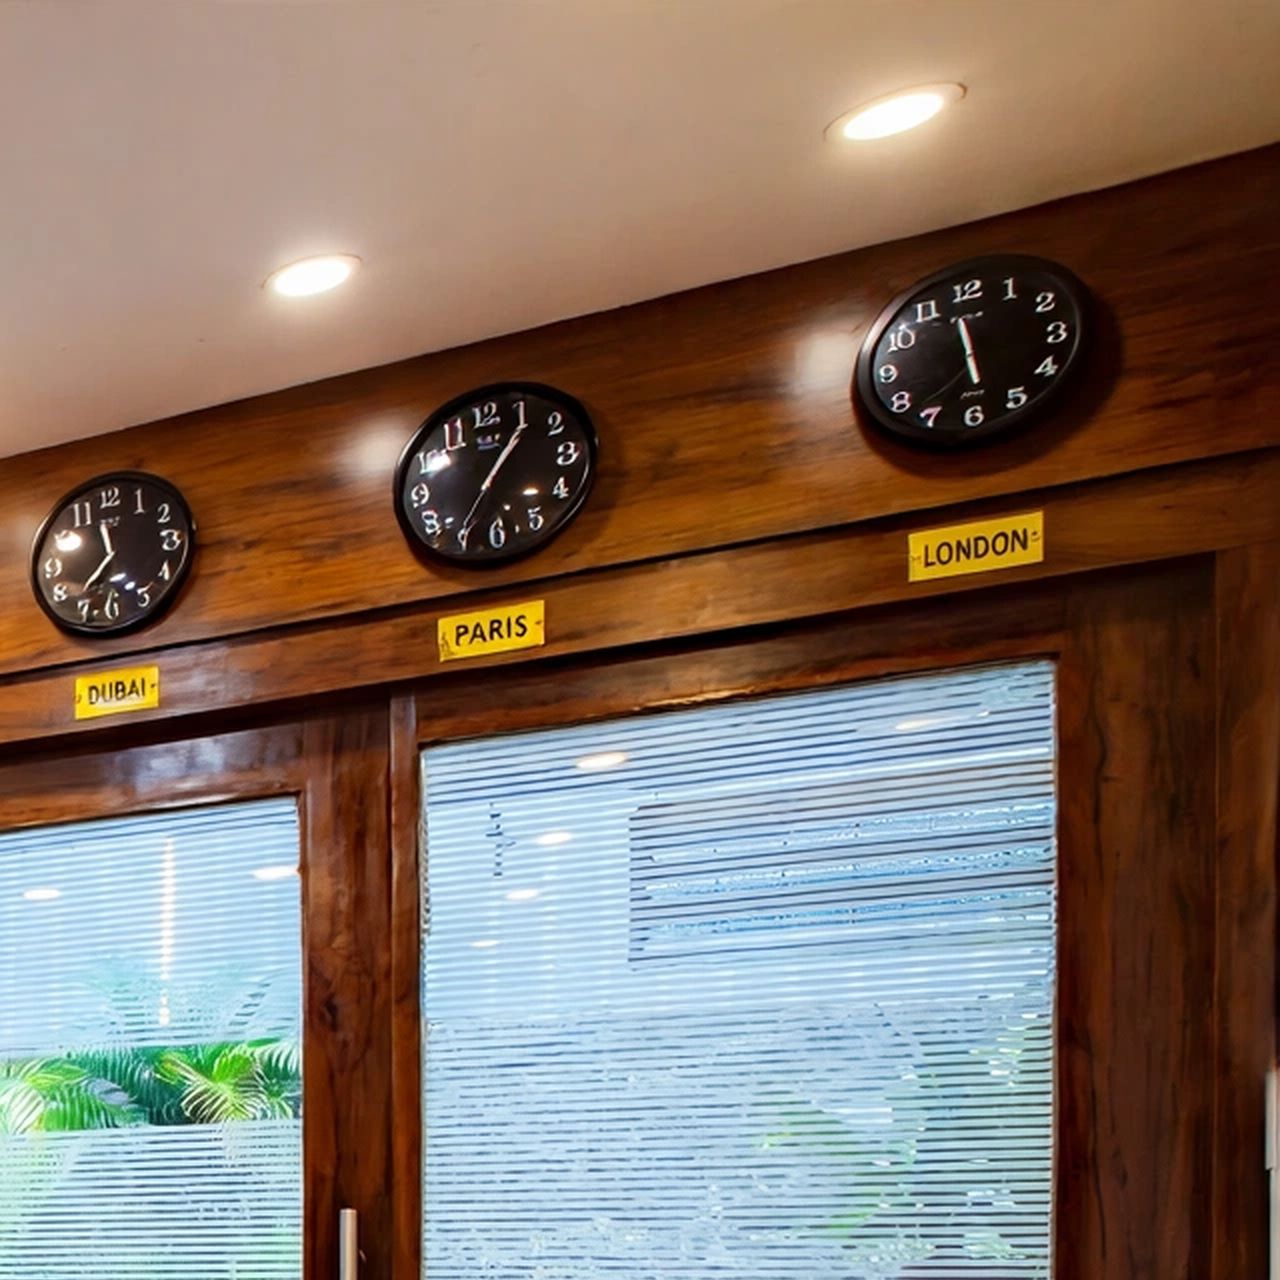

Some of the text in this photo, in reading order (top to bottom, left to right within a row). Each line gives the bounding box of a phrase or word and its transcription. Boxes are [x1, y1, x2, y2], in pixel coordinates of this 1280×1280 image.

[952, 280, 983, 303] 12
[1003, 277, 1017, 300] 1
[916, 300, 940, 322] 11
[1036, 292, 1056, 313] 2
[888, 328, 916, 353] 10
[1046, 321, 1067, 343] 3
[879, 364, 898, 383] 9
[1034, 355, 1058, 377] 4
[891, 391, 911, 413] 8
[1006, 387, 1028, 409] 5
[472, 402, 500, 428] 12
[513, 401, 528, 429] 1
[547, 412, 565, 436] 2
[920, 406, 942, 427] 7
[964, 406, 984, 426] 6
[557, 441, 579, 466] 3
[100, 487, 120, 509] 12
[411, 483, 429, 508] 9
[553, 476, 569, 498] 4
[134, 488, 145, 514] 1
[73, 502, 91, 527] 11
[157, 503, 171, 523] 2
[421, 509, 440, 534] 8
[528, 507, 544, 530] 5
[160, 529, 181, 550] 3
[490, 516, 505, 548] 6
[924, 528, 1028, 568] LONDON
[44, 558, 62, 578] 9
[53, 583, 68, 601] 8
[137, 582, 153, 607] 5
[105, 589, 119, 619] 6
[455, 615, 528, 646] PARIS
[88, 677, 146, 705] DUBAI
